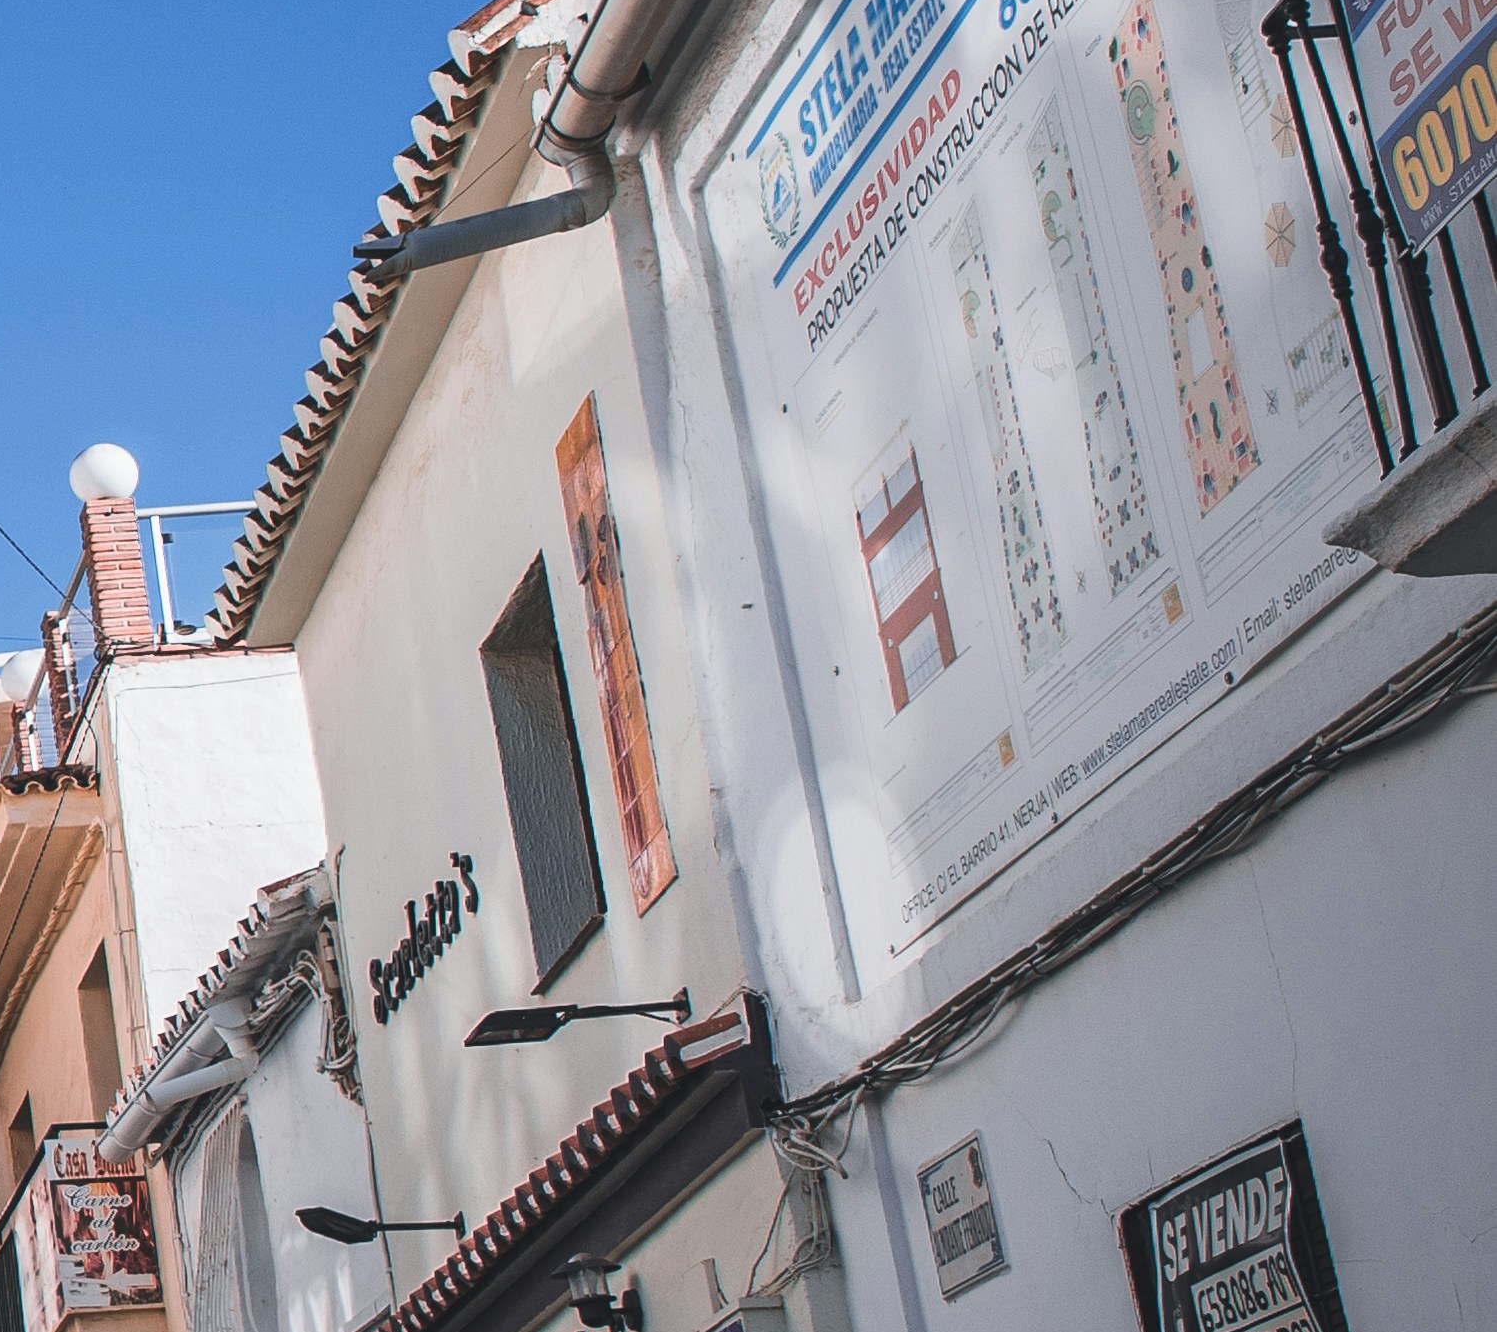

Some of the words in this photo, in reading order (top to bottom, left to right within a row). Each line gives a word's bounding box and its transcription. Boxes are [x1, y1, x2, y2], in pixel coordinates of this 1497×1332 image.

[798, 25, 868, 157] STELA
[809, 82, 879, 197] INMOBILIARIA
[880, 42, 908, 95] REAL
[1390, 28, 1442, 108] SE
[793, 68, 961, 317] EXCLUSIVIDAD
[806, 234, 886, 352] PROPUESTA
[884, 201, 908, 251] DE
[905, 42, 1022, 220] CONSTRUCCION
[1021, 10, 1049, 63] DE
[960, 840, 998, 879] BARRIO
[1013, 792, 1048, 830] NERJA
[1054, 764, 1081, 800] WEB:
[1080, 638, 1237, 777] www.stelamarerealestate.com
[1243, 598, 1283, 643] Email:
[1283, 547, 1360, 611] stelamare@
[54, 1143, 88, 1178] Casa
[64, 1185, 132, 1210] Carne
[933, 1176, 959, 1214] CALLE
[91, 1208, 117, 1230] al
[1162, 1212, 1190, 1282] SE
[1192, 1166, 1283, 1263] VENDE
